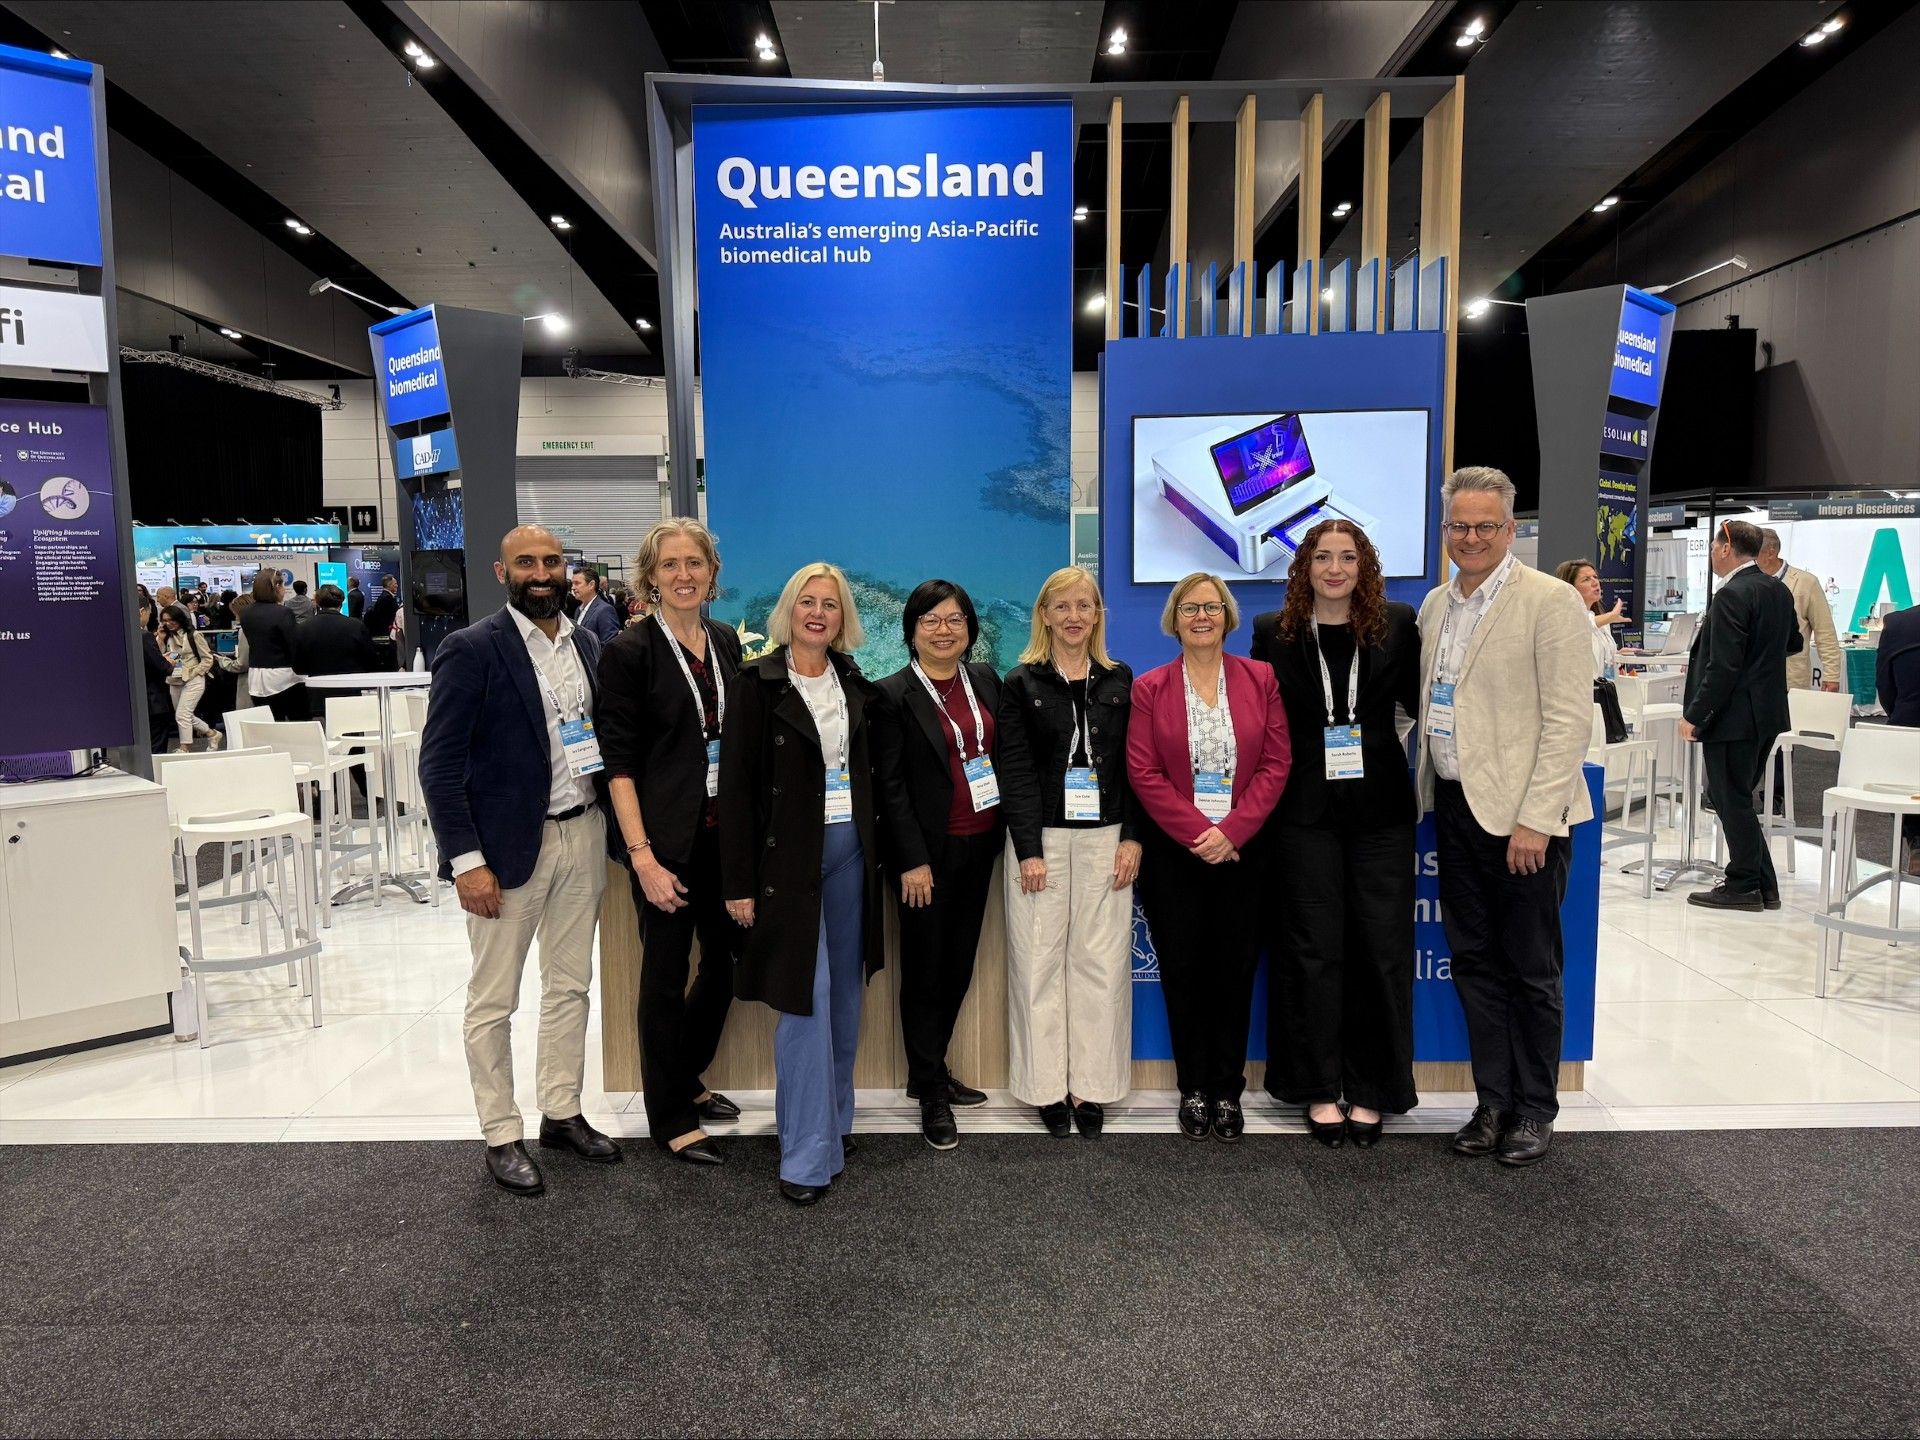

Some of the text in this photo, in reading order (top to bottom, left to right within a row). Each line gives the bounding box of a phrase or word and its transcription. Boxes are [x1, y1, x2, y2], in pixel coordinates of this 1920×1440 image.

[716, 151, 1044, 208] Queensland
[826, 222, 922, 242] emerging
[927, 219, 1039, 238] Asia-Pacific
[720, 246, 872, 264] biomedical hub
[1616, 329, 1656, 354] ueensland
[388, 344, 440, 376] Queensland
[389, 368, 438, 397] biomedical
[28, 421, 63, 435] Hub
[542, 441, 594, 450] EMERGENCY EXIT
[1818, 503, 1916, 516] Integra Biosciences
